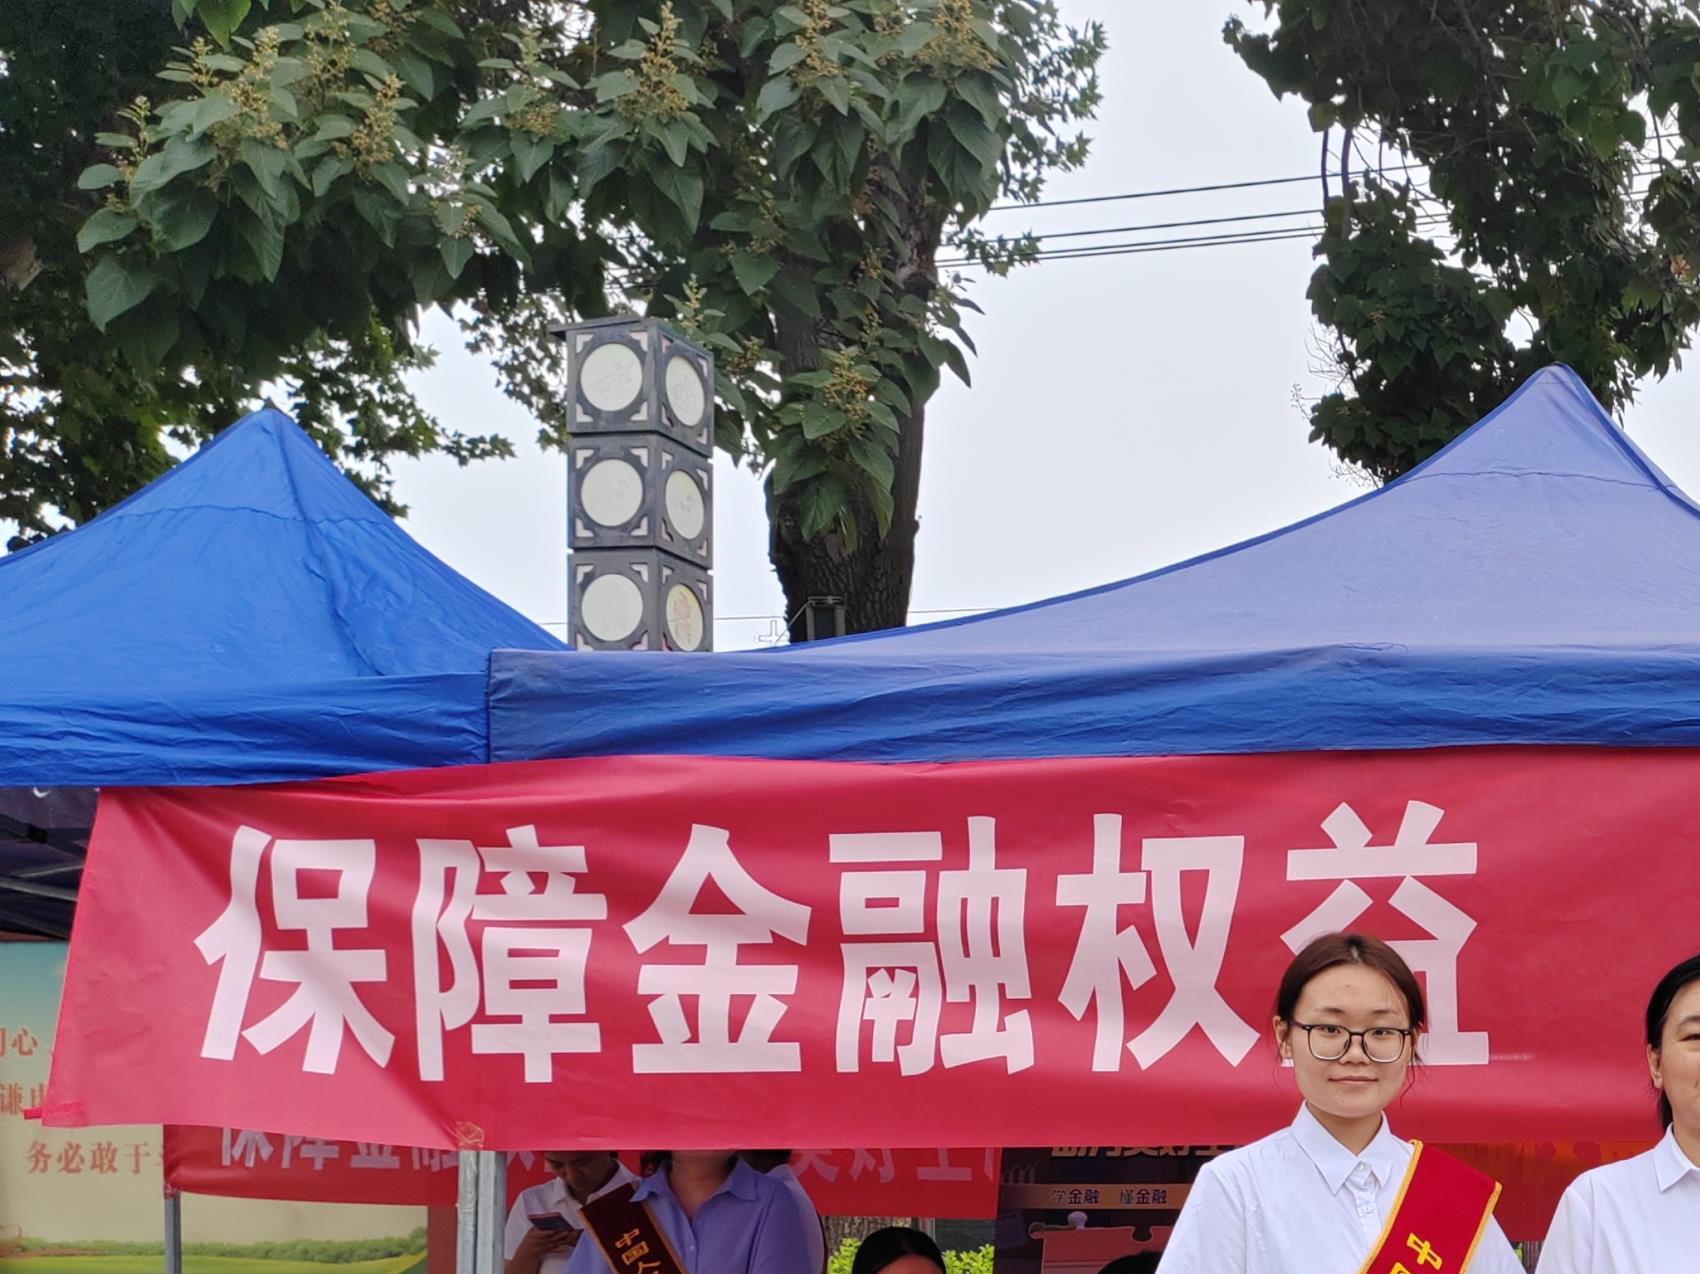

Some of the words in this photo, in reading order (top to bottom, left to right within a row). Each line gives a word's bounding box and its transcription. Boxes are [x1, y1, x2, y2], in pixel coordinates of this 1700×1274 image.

[194, 800, 1489, 1082] 保障金融权益
[27, 1140, 163, 1175] 务必敢于
